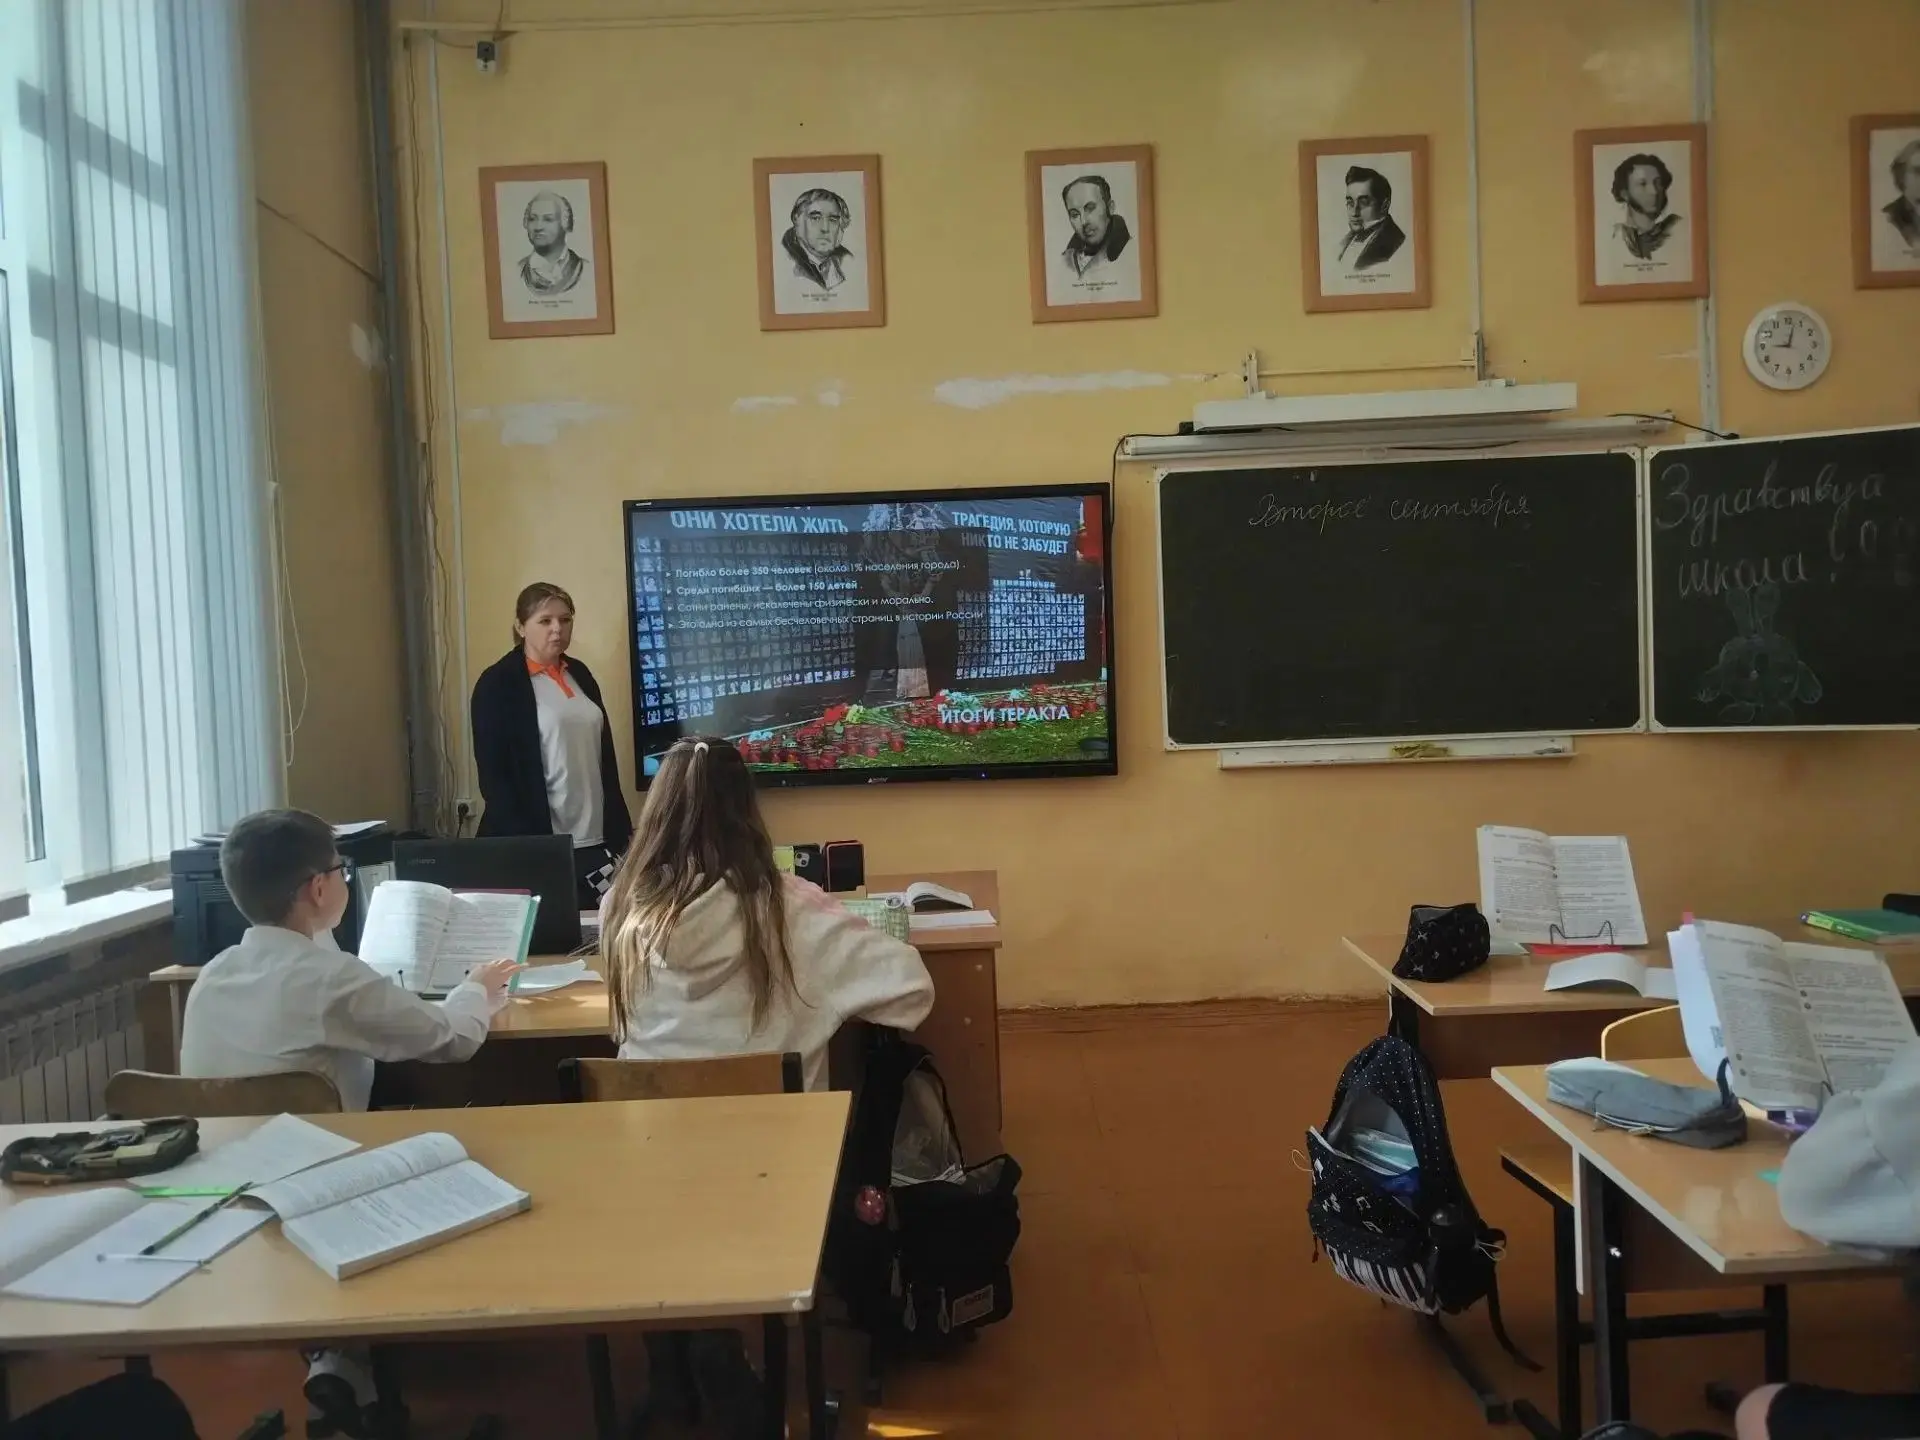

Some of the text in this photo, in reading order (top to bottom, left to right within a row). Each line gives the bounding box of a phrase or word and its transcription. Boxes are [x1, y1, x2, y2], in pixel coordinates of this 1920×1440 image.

[671, 511, 849, 533] ОНИ ХОТЕЛИ ЖИТЬ
[952, 511, 1071, 537] ТРАГЕДИЯ, КОТОРУЮ
[1004, 535, 1019, 550] НЕ
[1021, 538, 1068, 556] ЗАБУДЕТ
[676, 566, 717, 579] Погибло
[719, 566, 750, 577] более
[752, 566, 769, 576] 350
[771, 565, 812, 576] человек
[850, 562, 863, 573] 1%
[865, 562, 918, 572] населения
[676, 586, 709, 597] Среди
[712, 584, 760, 595] погибших
[775, 582, 806, 592] более
[808, 582, 825, 591] 150
[827, 580, 858, 592] детей
[677, 602, 708, 613] Сотни
[753, 600, 811, 610] искалечены
[814, 596, 870, 609] физически
[726, 619, 737, 628] из
[739, 617, 773, 628] самых
[775, 615, 850, 627] бесчеловечных
[851, 613, 894, 626] страниц
[902, 612, 943, 623] истории
[945, 609, 984, 621] России
[942, 706, 1070, 724] ИТОГИ ТЕРАКТА
